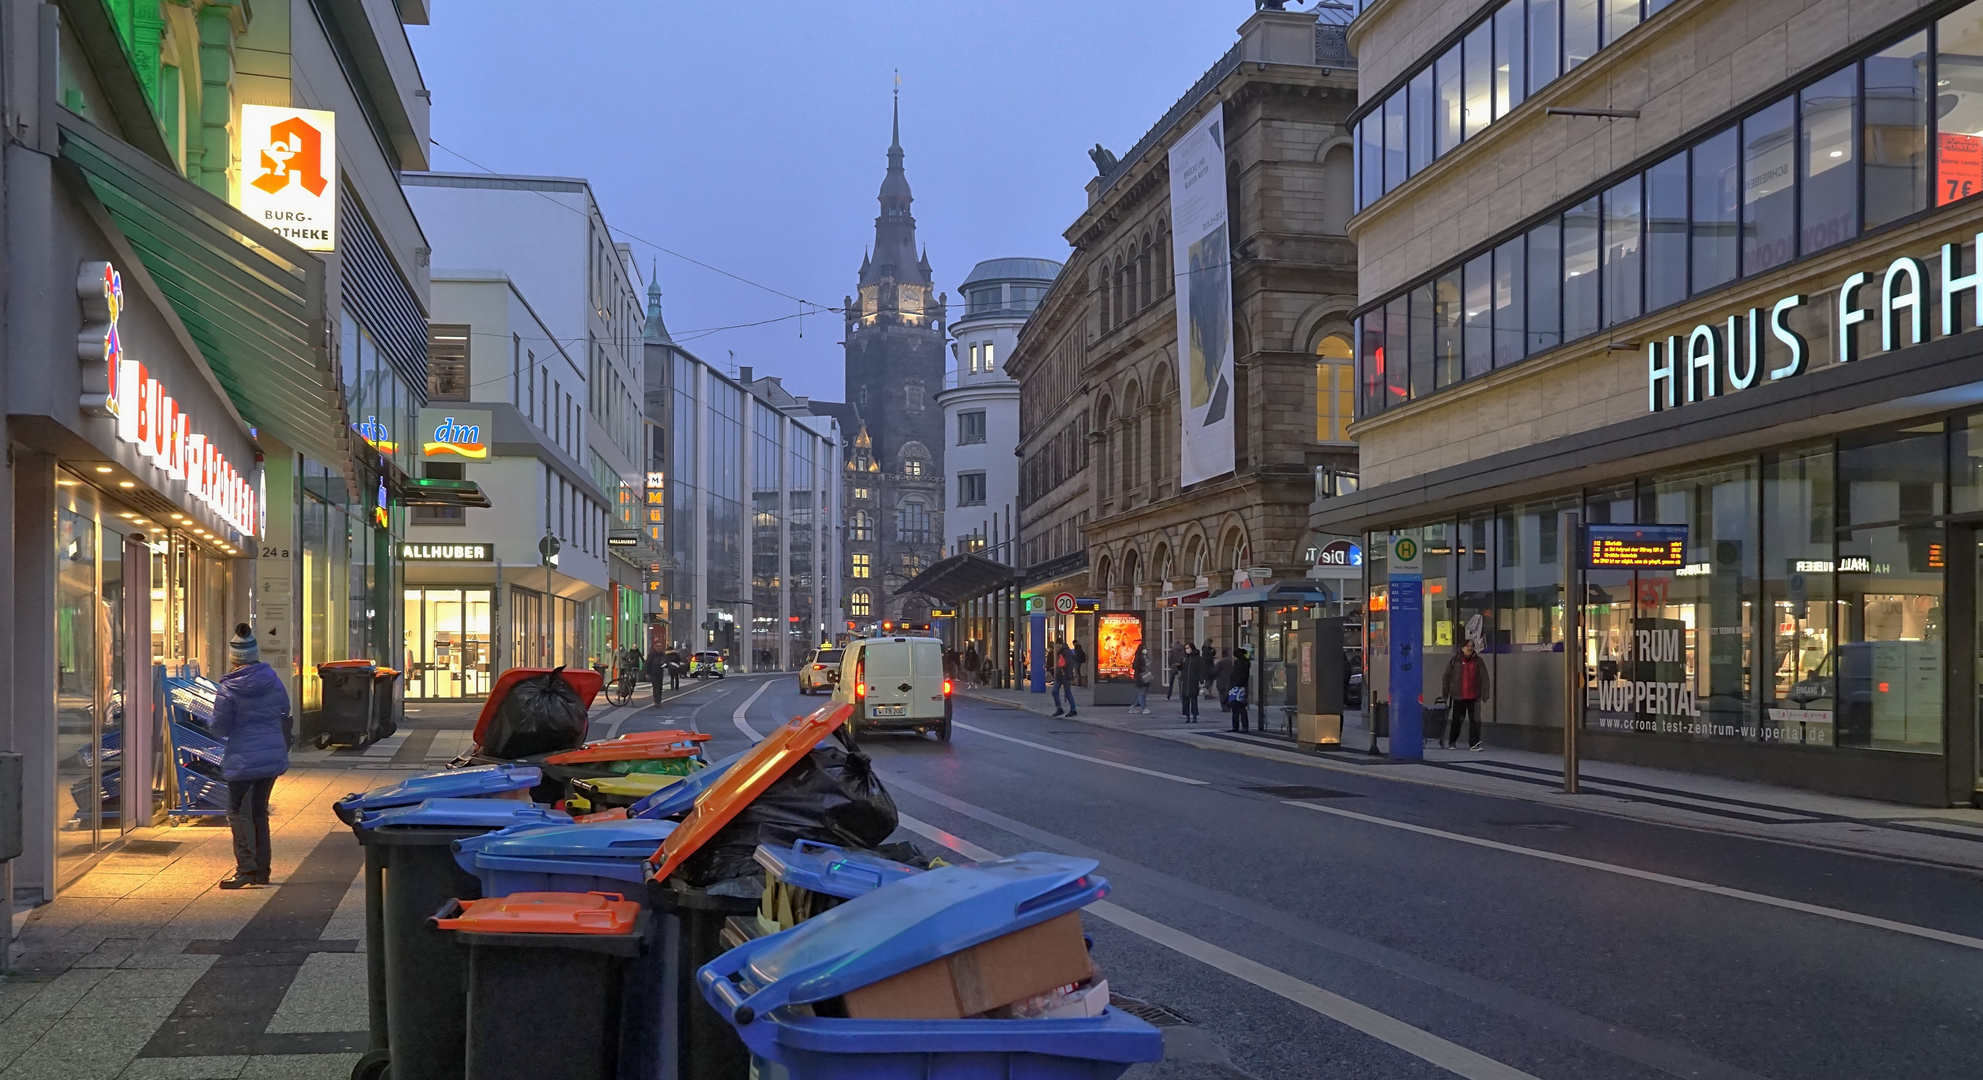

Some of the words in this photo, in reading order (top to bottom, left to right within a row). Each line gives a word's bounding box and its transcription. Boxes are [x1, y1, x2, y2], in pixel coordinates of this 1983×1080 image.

[265, 210, 312, 222] BURG-
[270, 227, 329, 240] OTHEKE
[1649, 294, 1809, 412] HAUS
[434, 417, 480, 443] dm
[262, 547, 278, 558] 24
[281, 549, 289, 558] a
[1628, 578, 1670, 609] TEST
[1060, 599, 1072, 609] 20
[1599, 629, 1679, 662] ZENTRUM
[1600, 680, 1700, 717] WUPPERTAL
[1796, 686, 1818, 696] EINGANG
